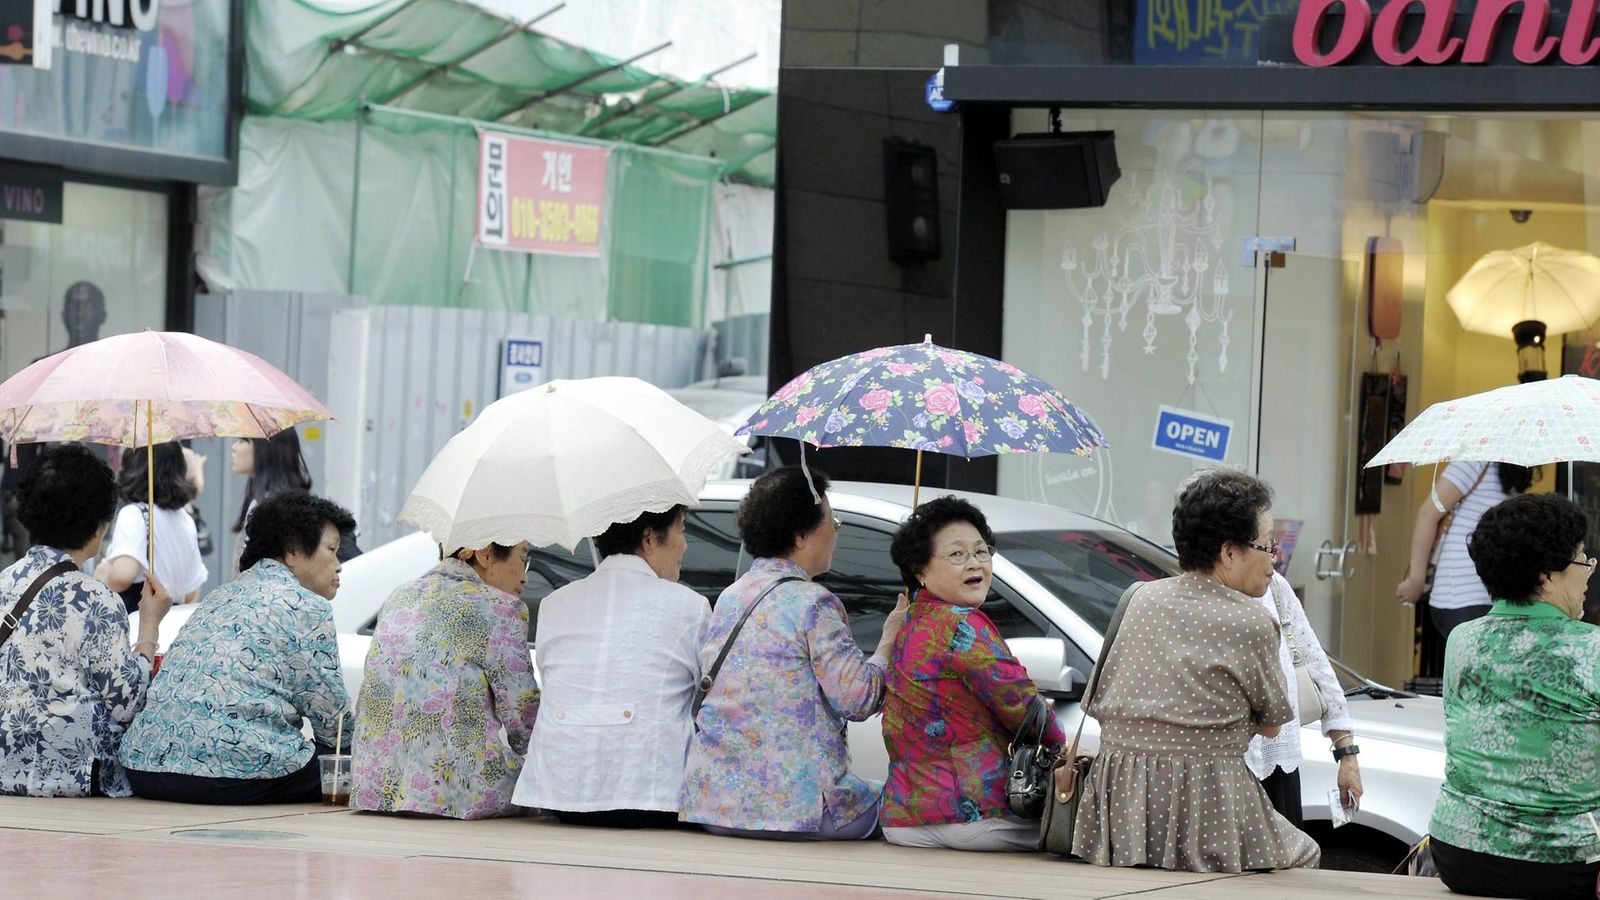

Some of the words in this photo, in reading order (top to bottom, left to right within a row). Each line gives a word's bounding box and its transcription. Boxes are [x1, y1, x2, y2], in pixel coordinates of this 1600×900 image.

[4, 185, 44, 214] VINO
[485, 142, 503, 239] 문의
[1166, 421, 1220, 448] OPEN
